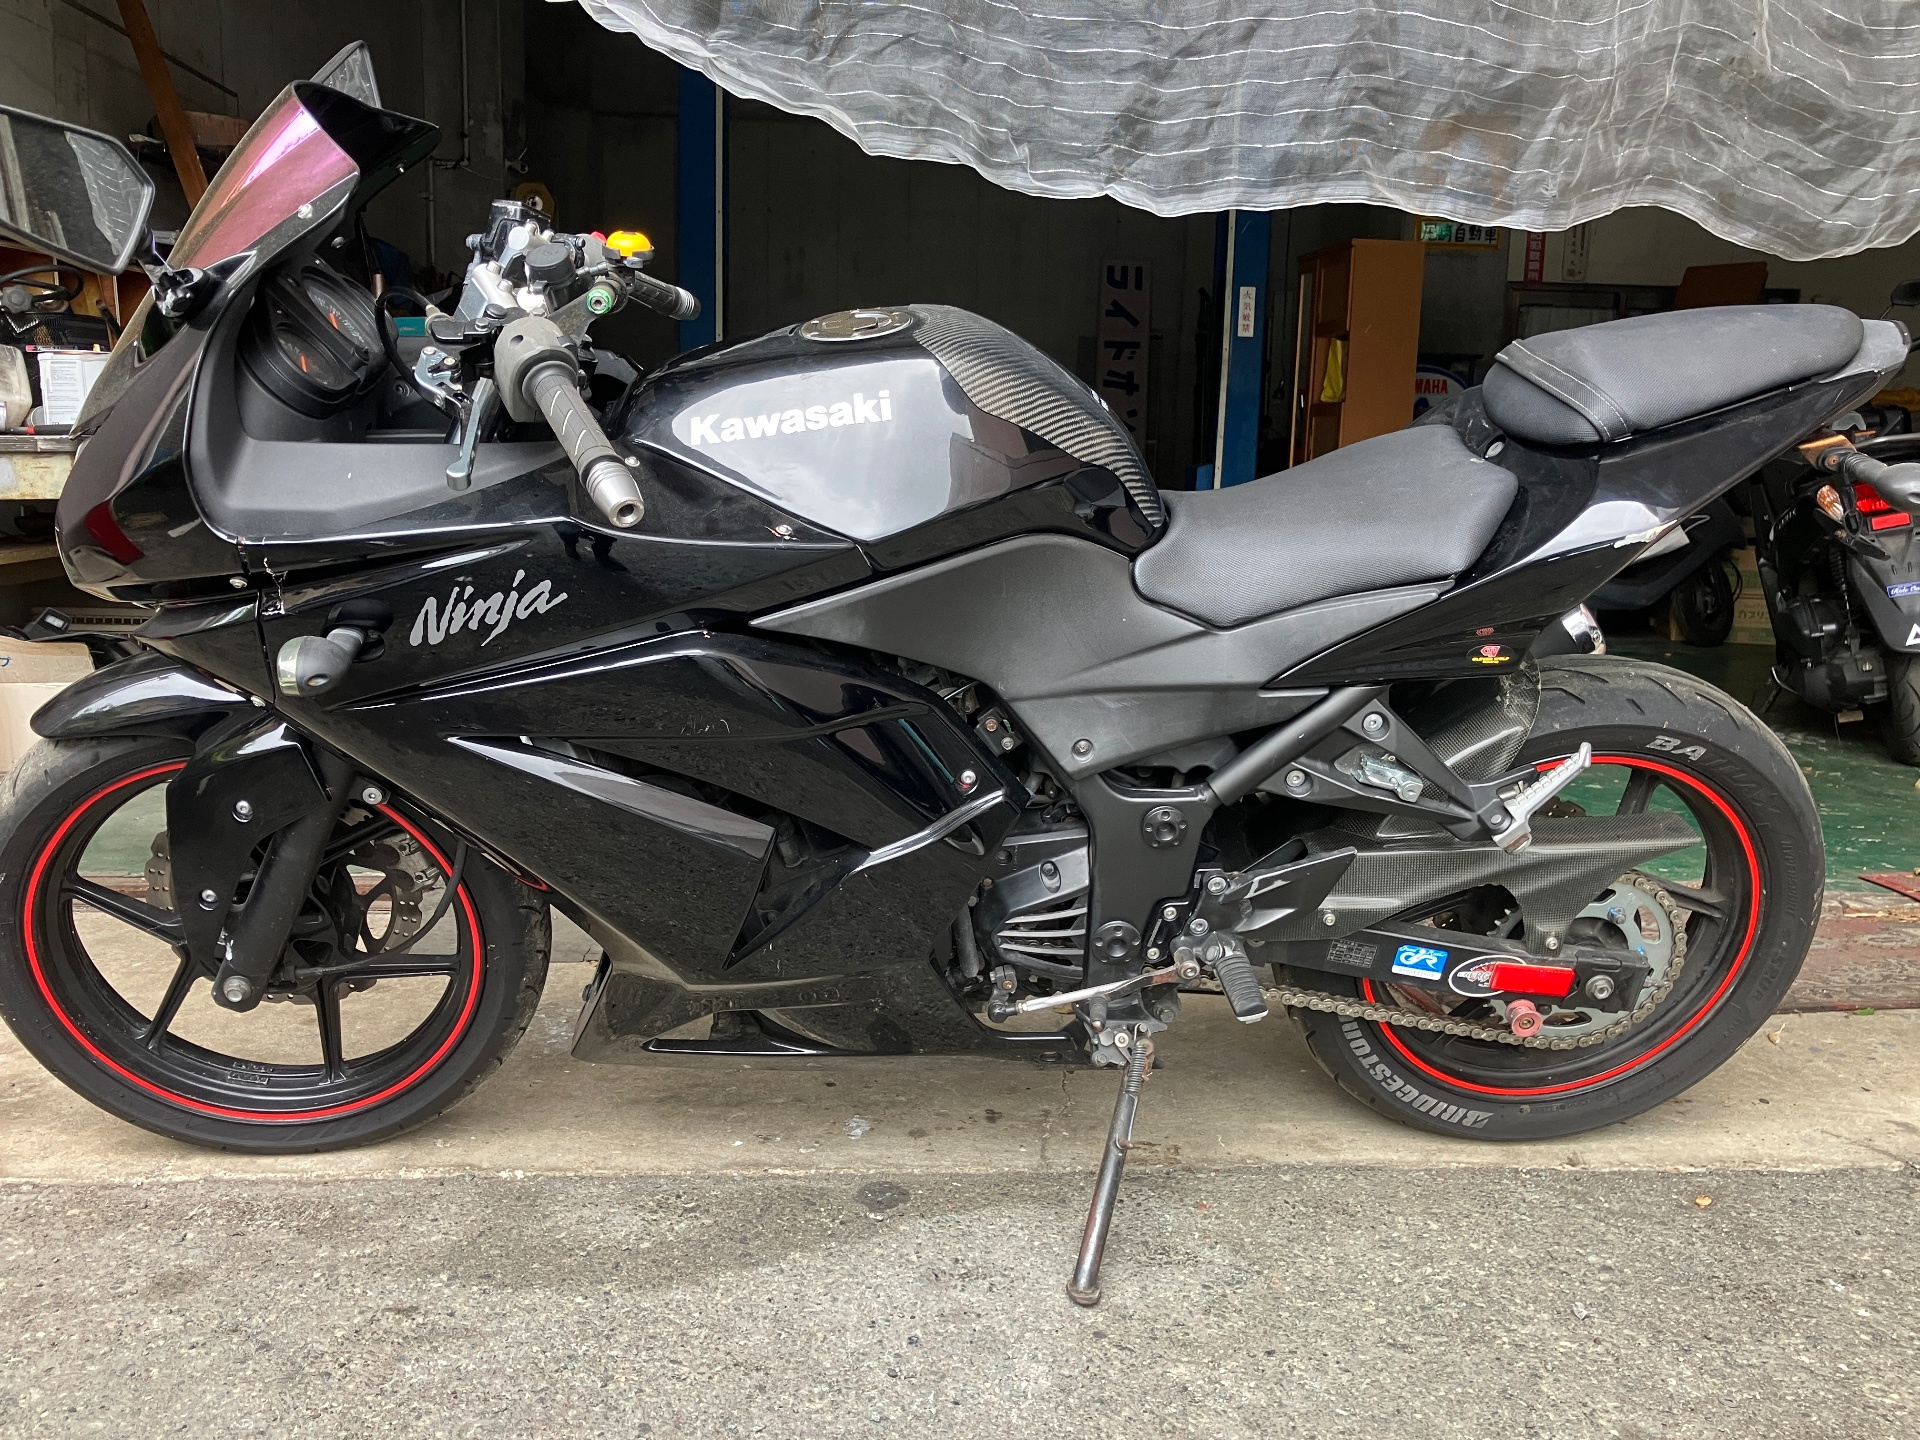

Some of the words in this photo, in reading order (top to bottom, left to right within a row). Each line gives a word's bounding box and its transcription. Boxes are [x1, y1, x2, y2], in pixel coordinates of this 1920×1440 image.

[1415, 379, 1448, 394] MAHA
[691, 390, 892, 446] Kawasaki
[409, 569, 568, 647] Ninja
